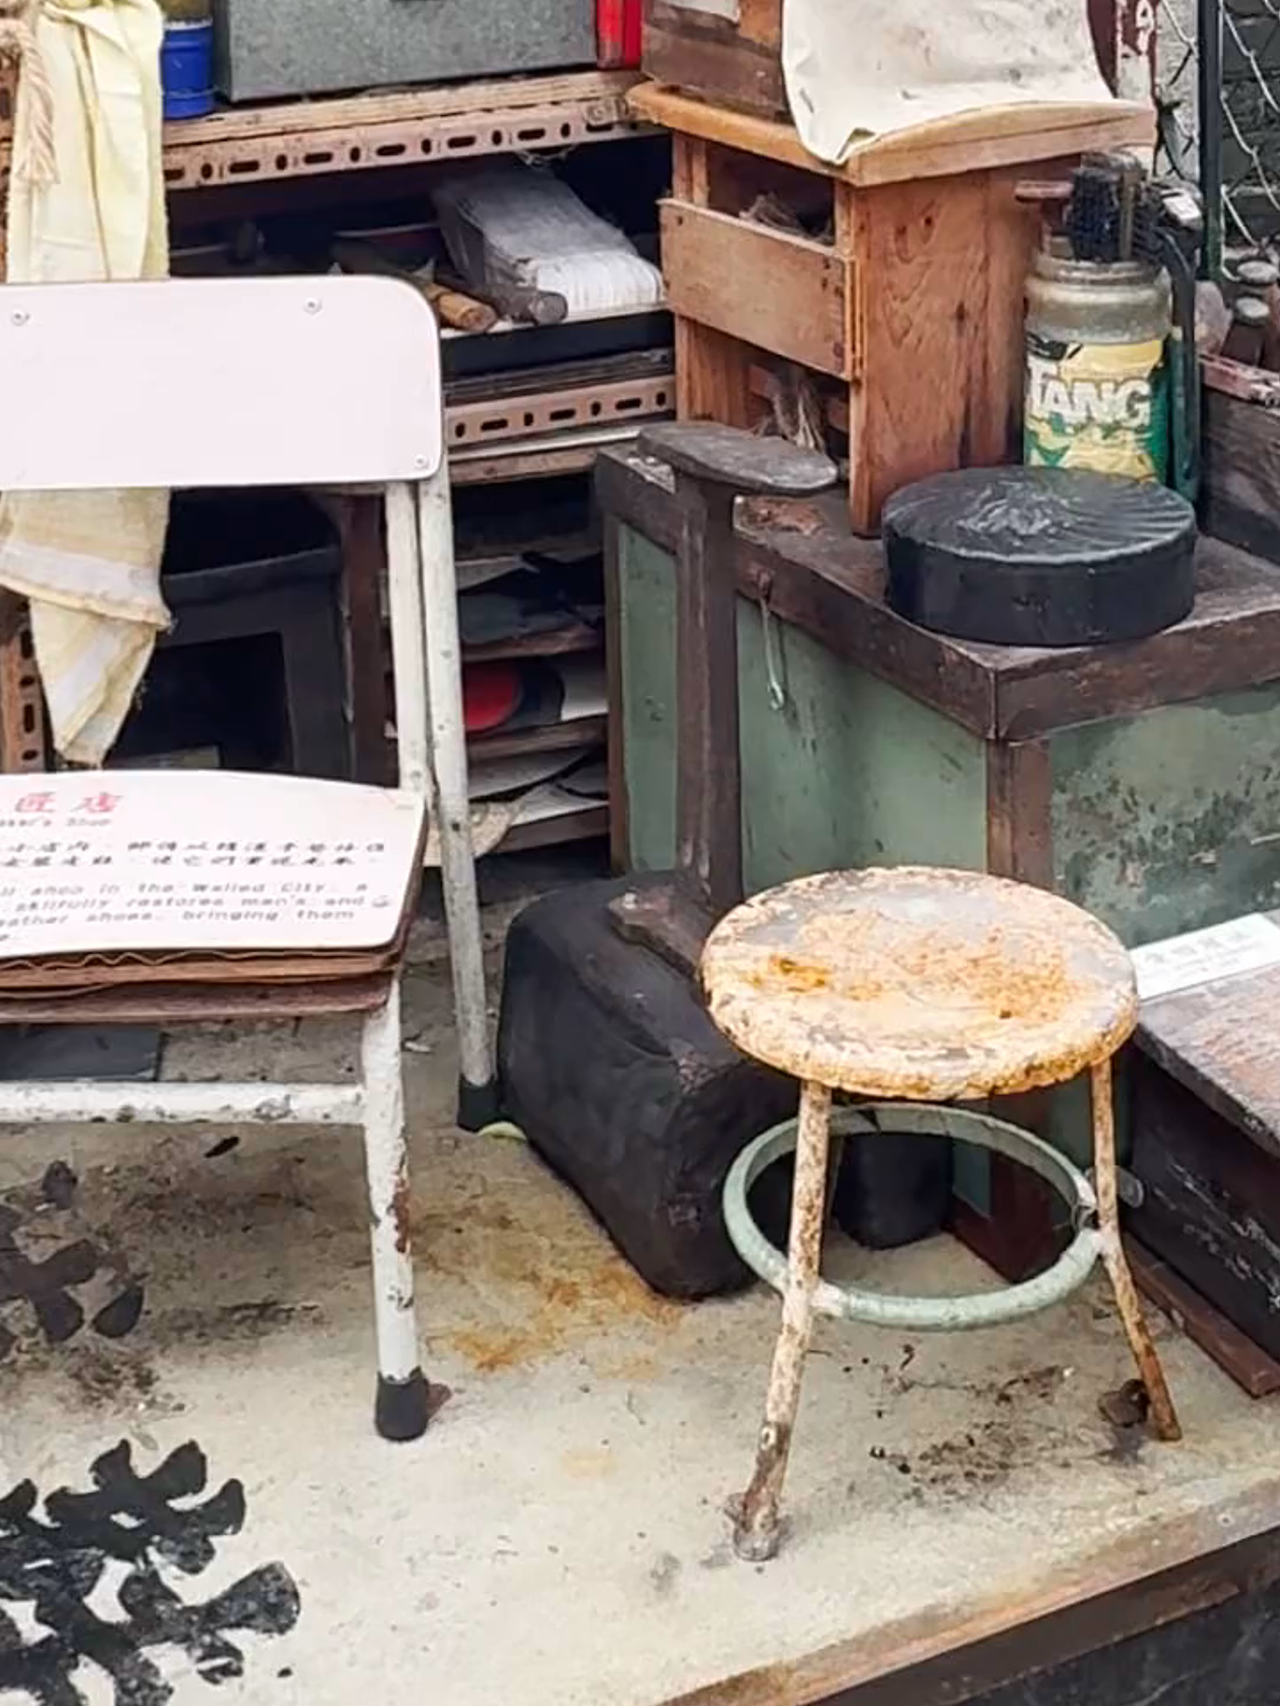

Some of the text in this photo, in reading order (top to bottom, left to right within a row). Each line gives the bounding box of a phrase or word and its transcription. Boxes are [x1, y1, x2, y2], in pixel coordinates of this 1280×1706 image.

[138, 882, 174, 893] the
[192, 882, 266, 893] Walled
[182, 909, 280, 922] bringing
[297, 909, 355, 920] them
